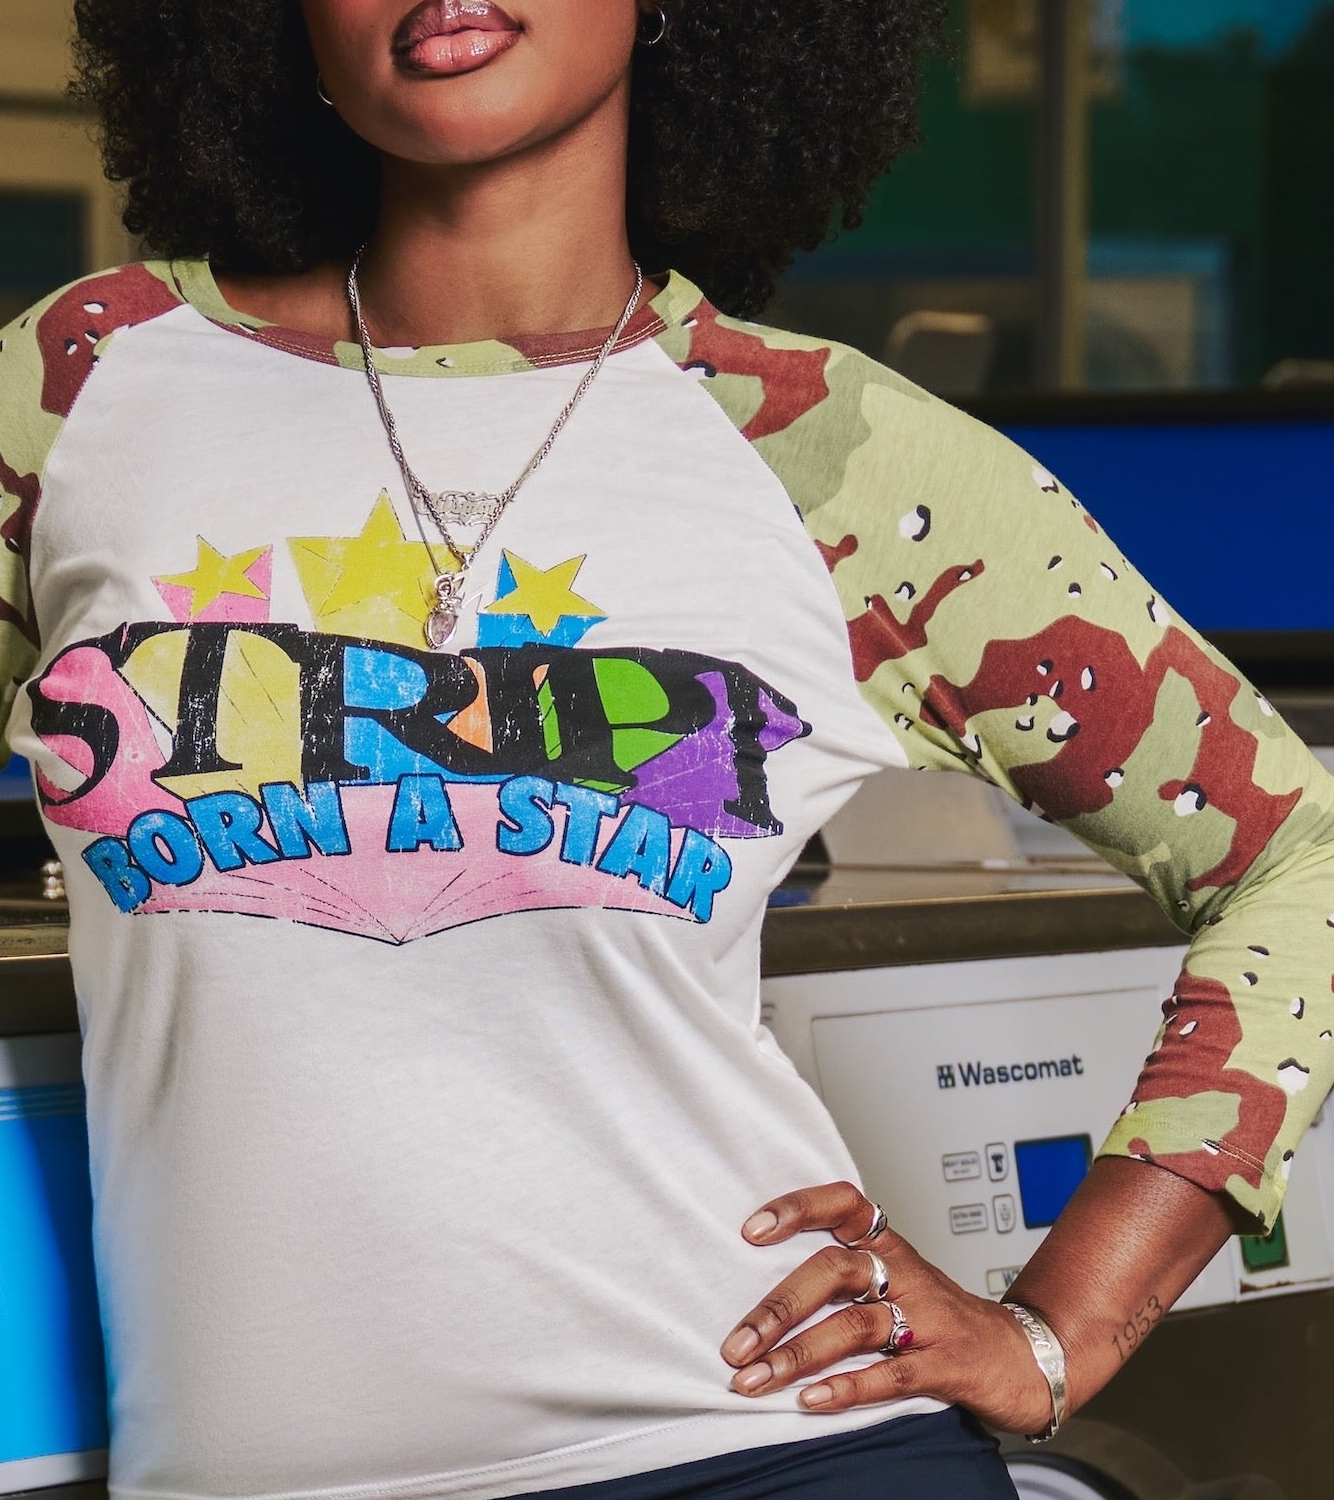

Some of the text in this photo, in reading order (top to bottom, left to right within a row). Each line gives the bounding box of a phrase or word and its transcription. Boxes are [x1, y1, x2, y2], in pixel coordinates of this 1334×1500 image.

[81, 772, 735, 925] BORN A STAR
[958, 1053, 1084, 1088] Wascomat
[1111, 1295, 1164, 1361] 1953
